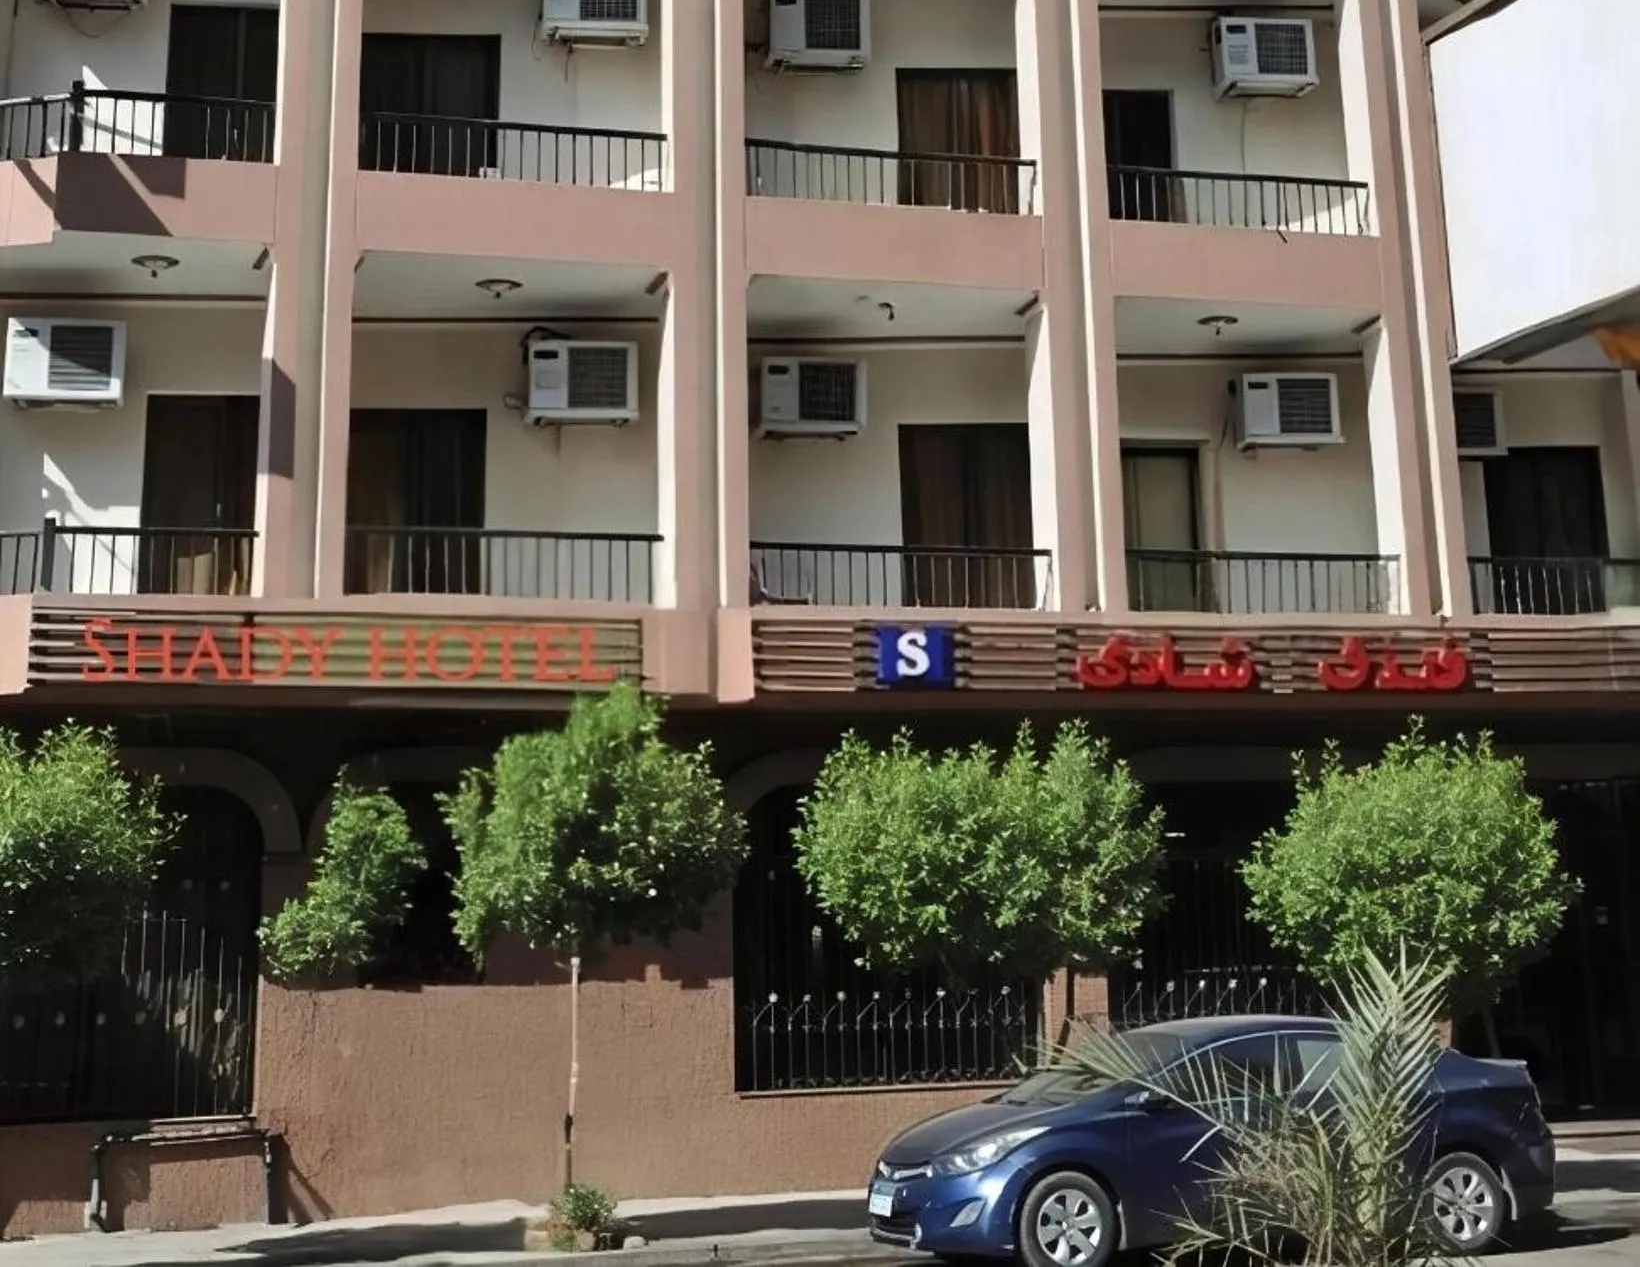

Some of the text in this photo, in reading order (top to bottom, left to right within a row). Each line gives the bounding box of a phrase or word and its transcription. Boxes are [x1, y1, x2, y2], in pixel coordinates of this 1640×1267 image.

[81, 615, 614, 682] SHADY HOTEL
[896, 631, 930, 677] S
